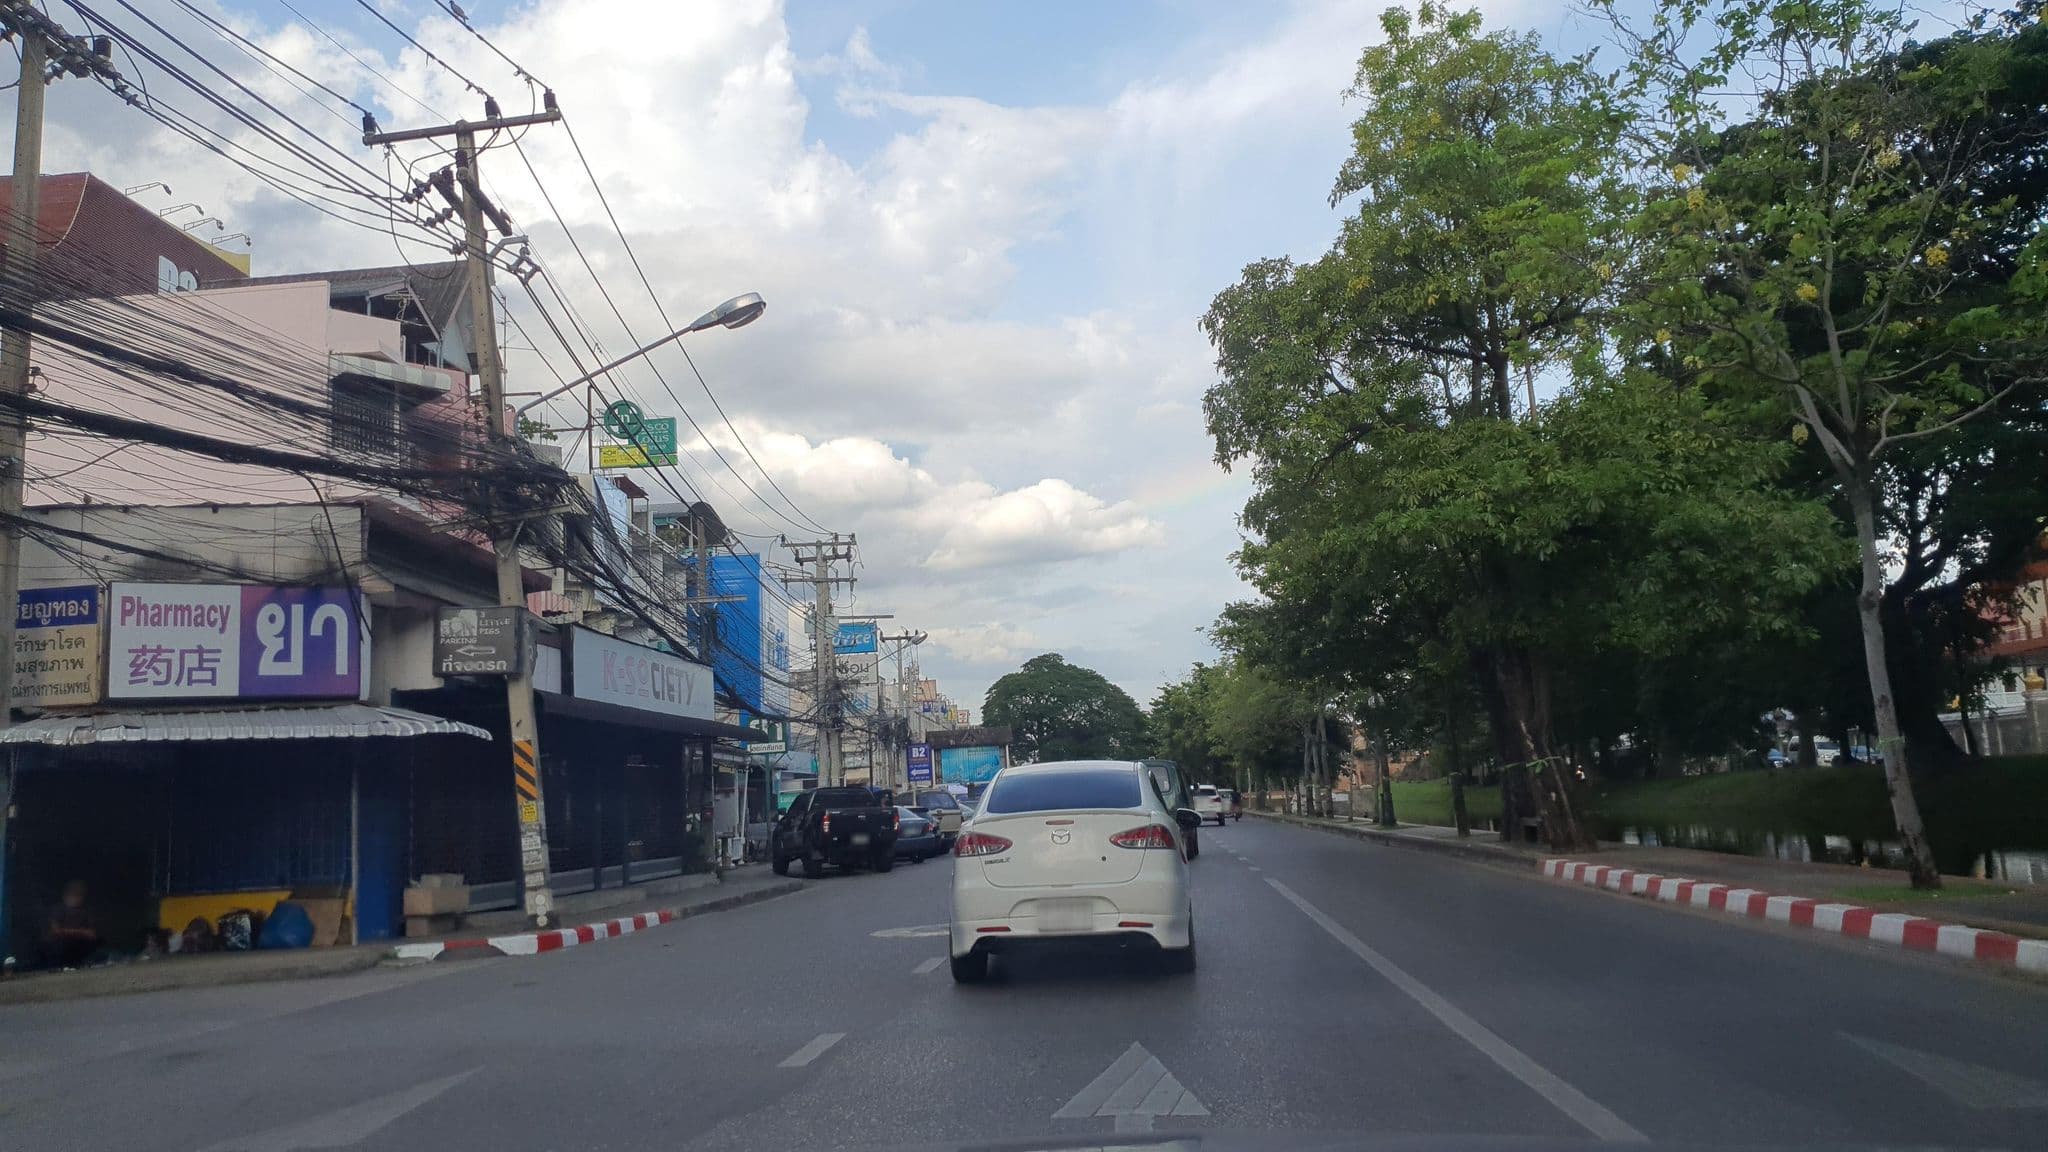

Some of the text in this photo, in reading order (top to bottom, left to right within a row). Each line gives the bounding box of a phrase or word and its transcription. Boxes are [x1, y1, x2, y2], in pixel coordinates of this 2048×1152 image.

[120, 595, 231, 634] Pharmacy
[256, 602, 349, 676] ยา
[128, 644, 222, 687] 药店
[912, 747, 926, 758] B2
